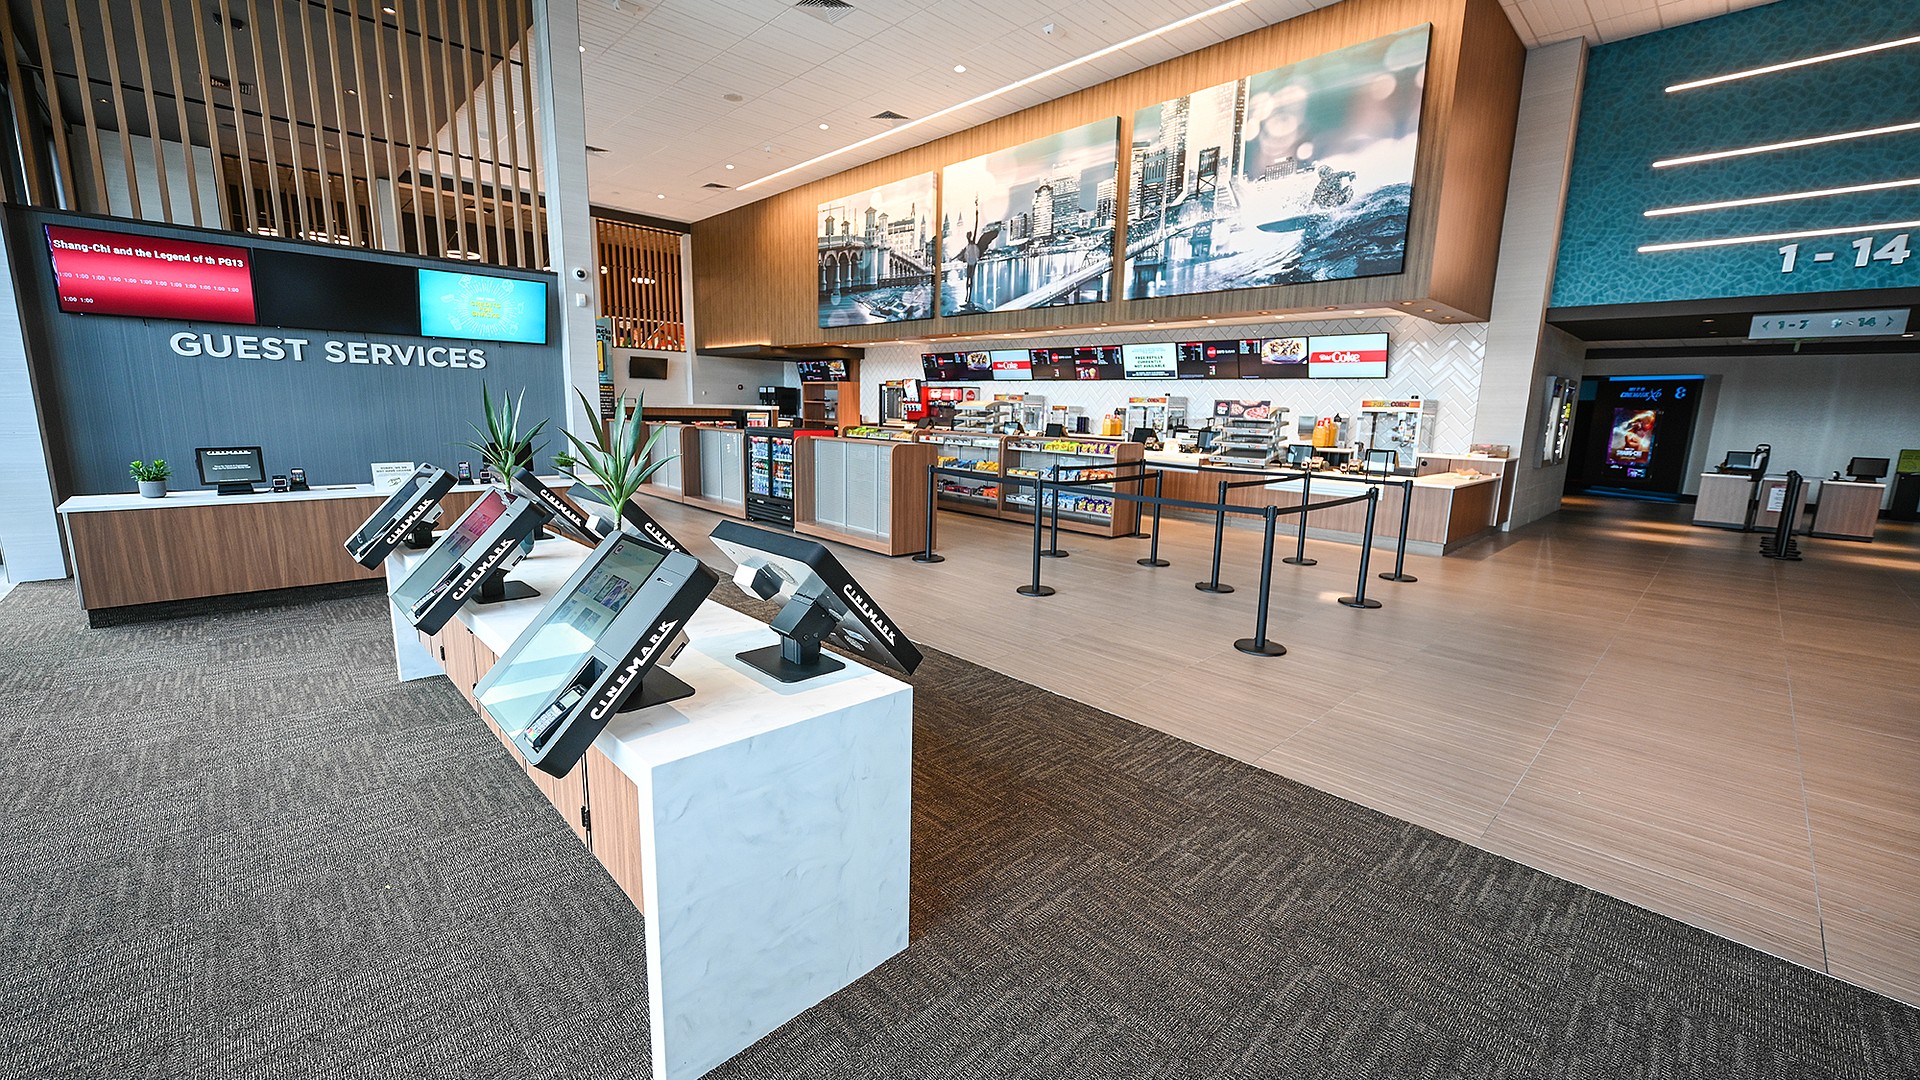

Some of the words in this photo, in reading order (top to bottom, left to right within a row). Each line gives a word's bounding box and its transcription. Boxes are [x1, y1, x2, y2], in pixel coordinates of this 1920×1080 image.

[53, 240, 111, 253] Shang-Chi
[113, 247, 132, 256] and
[134, 248, 152, 258] the
[154, 250, 190, 263] Legend
[192, 255, 203, 264] of
[205, 256, 216, 265] th
[218, 258, 244, 268] PG13
[1778, 244, 1798, 272] 1
[1852, 234, 1911, 268] 14
[169, 332, 308, 361] GUEST
[324, 340, 486, 370] SERVICES
[1331, 351, 1360, 364] Coke
[386, 499, 435, 545] CINEMARK
[540, 489, 582, 527] CINEMARK
[644, 522, 680, 552] CINEM
[452, 538, 516, 600] CINEMARK
[843, 584, 896, 646] CINEMARK
[590, 619, 679, 720] CINEMARK
